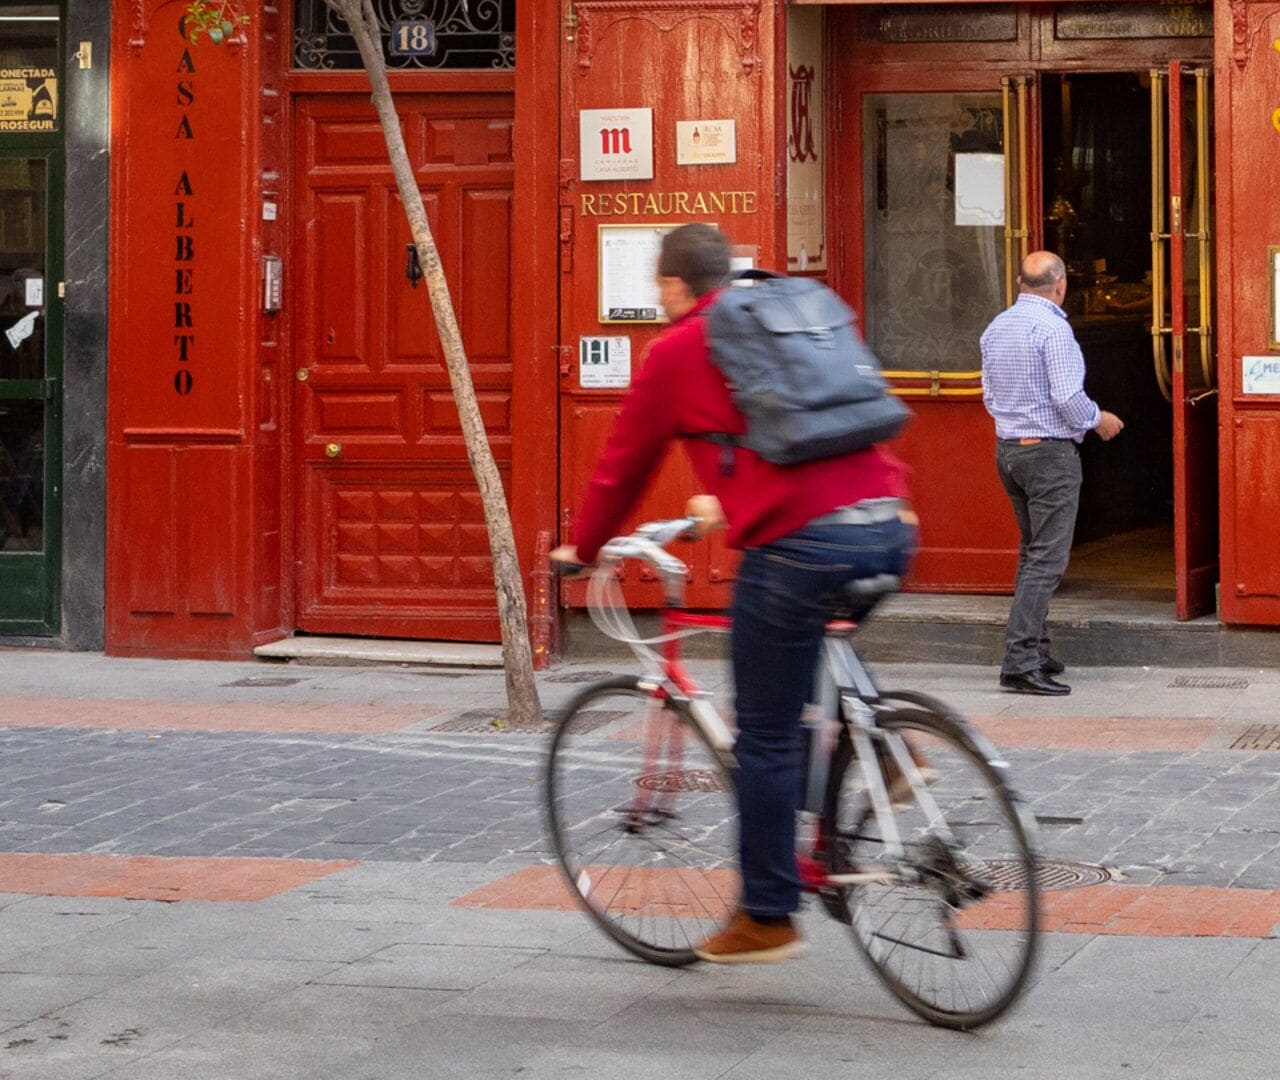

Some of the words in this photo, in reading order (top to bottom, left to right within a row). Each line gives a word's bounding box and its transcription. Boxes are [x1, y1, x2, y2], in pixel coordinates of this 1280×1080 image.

[397, 24, 428, 51] 18
[580, 191, 758, 216] RESTAURANTE
[174, 171, 195, 396] ALBERTO
